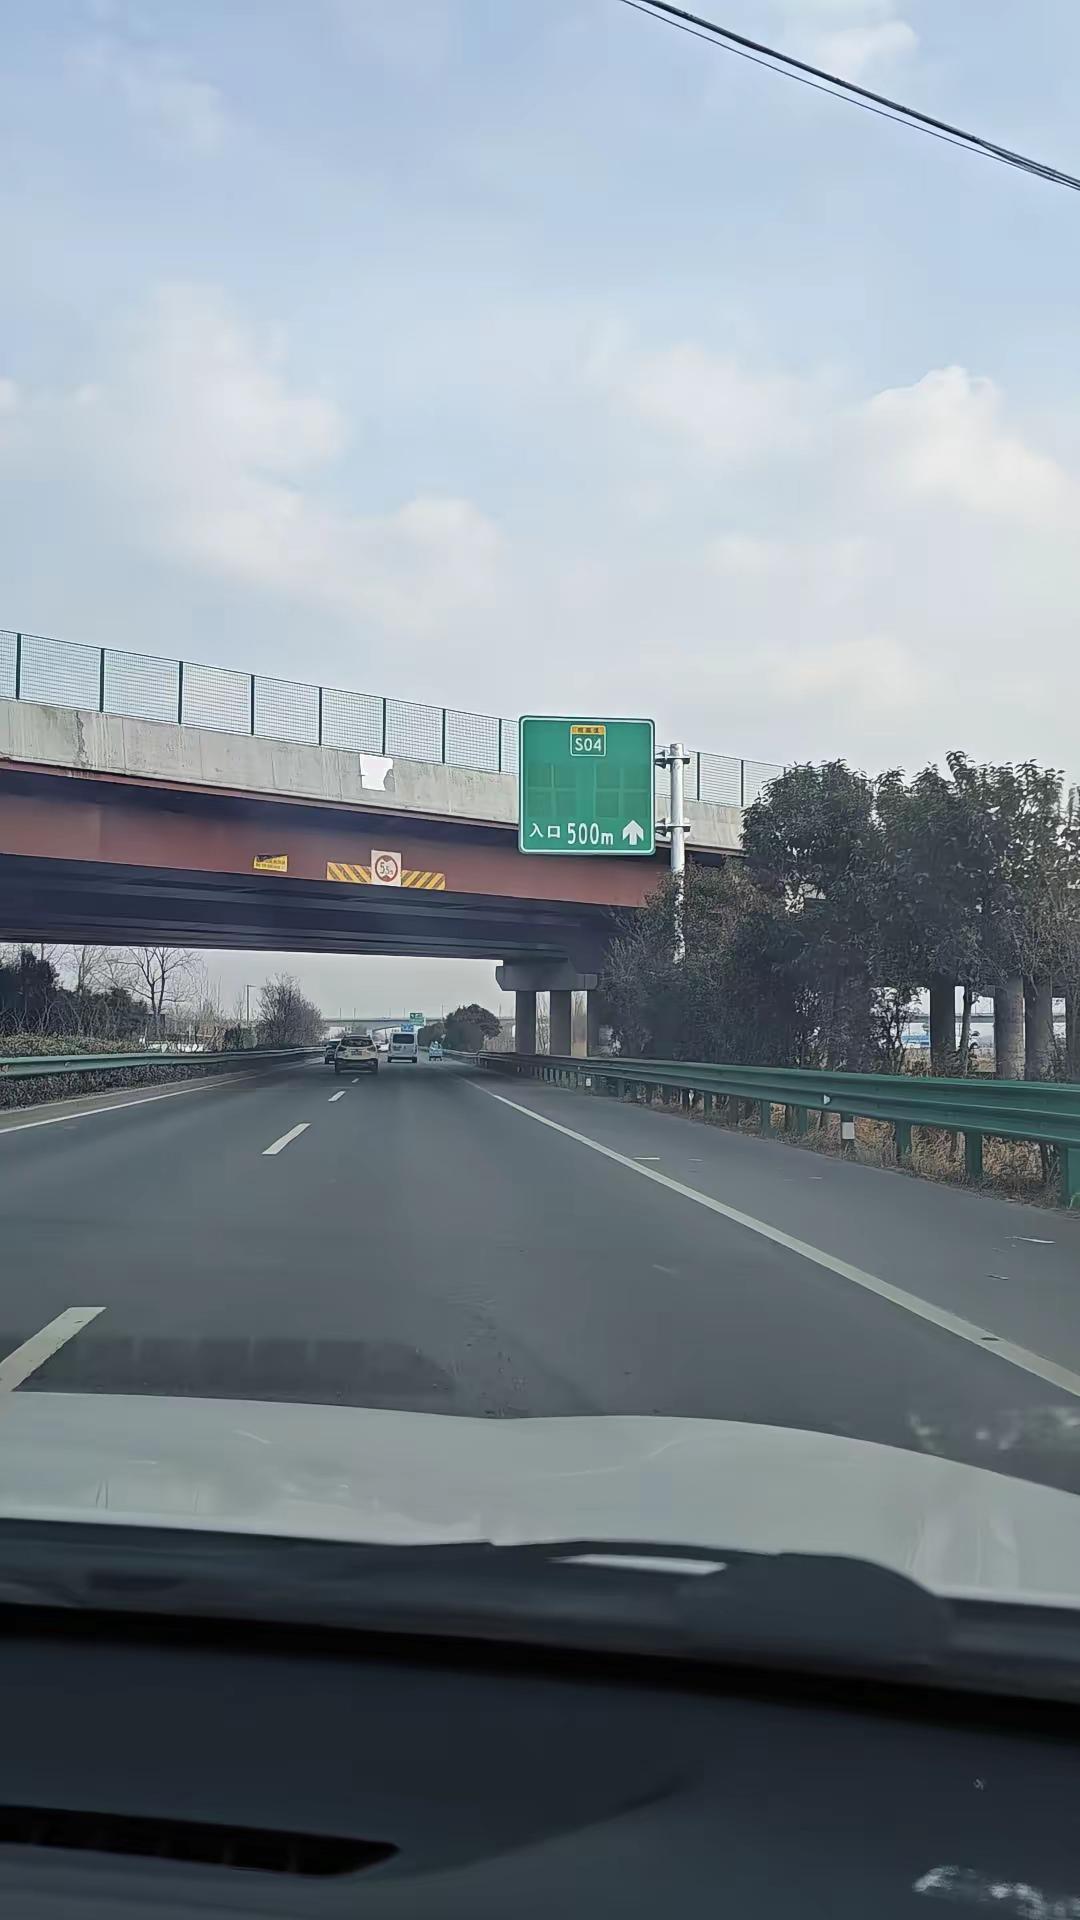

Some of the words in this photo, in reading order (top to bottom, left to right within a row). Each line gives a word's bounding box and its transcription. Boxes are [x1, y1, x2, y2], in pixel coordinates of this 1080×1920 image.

[575, 738, 601, 751] S04
[529, 823, 560, 838] 入口
[567, 822, 614, 845] 500m
